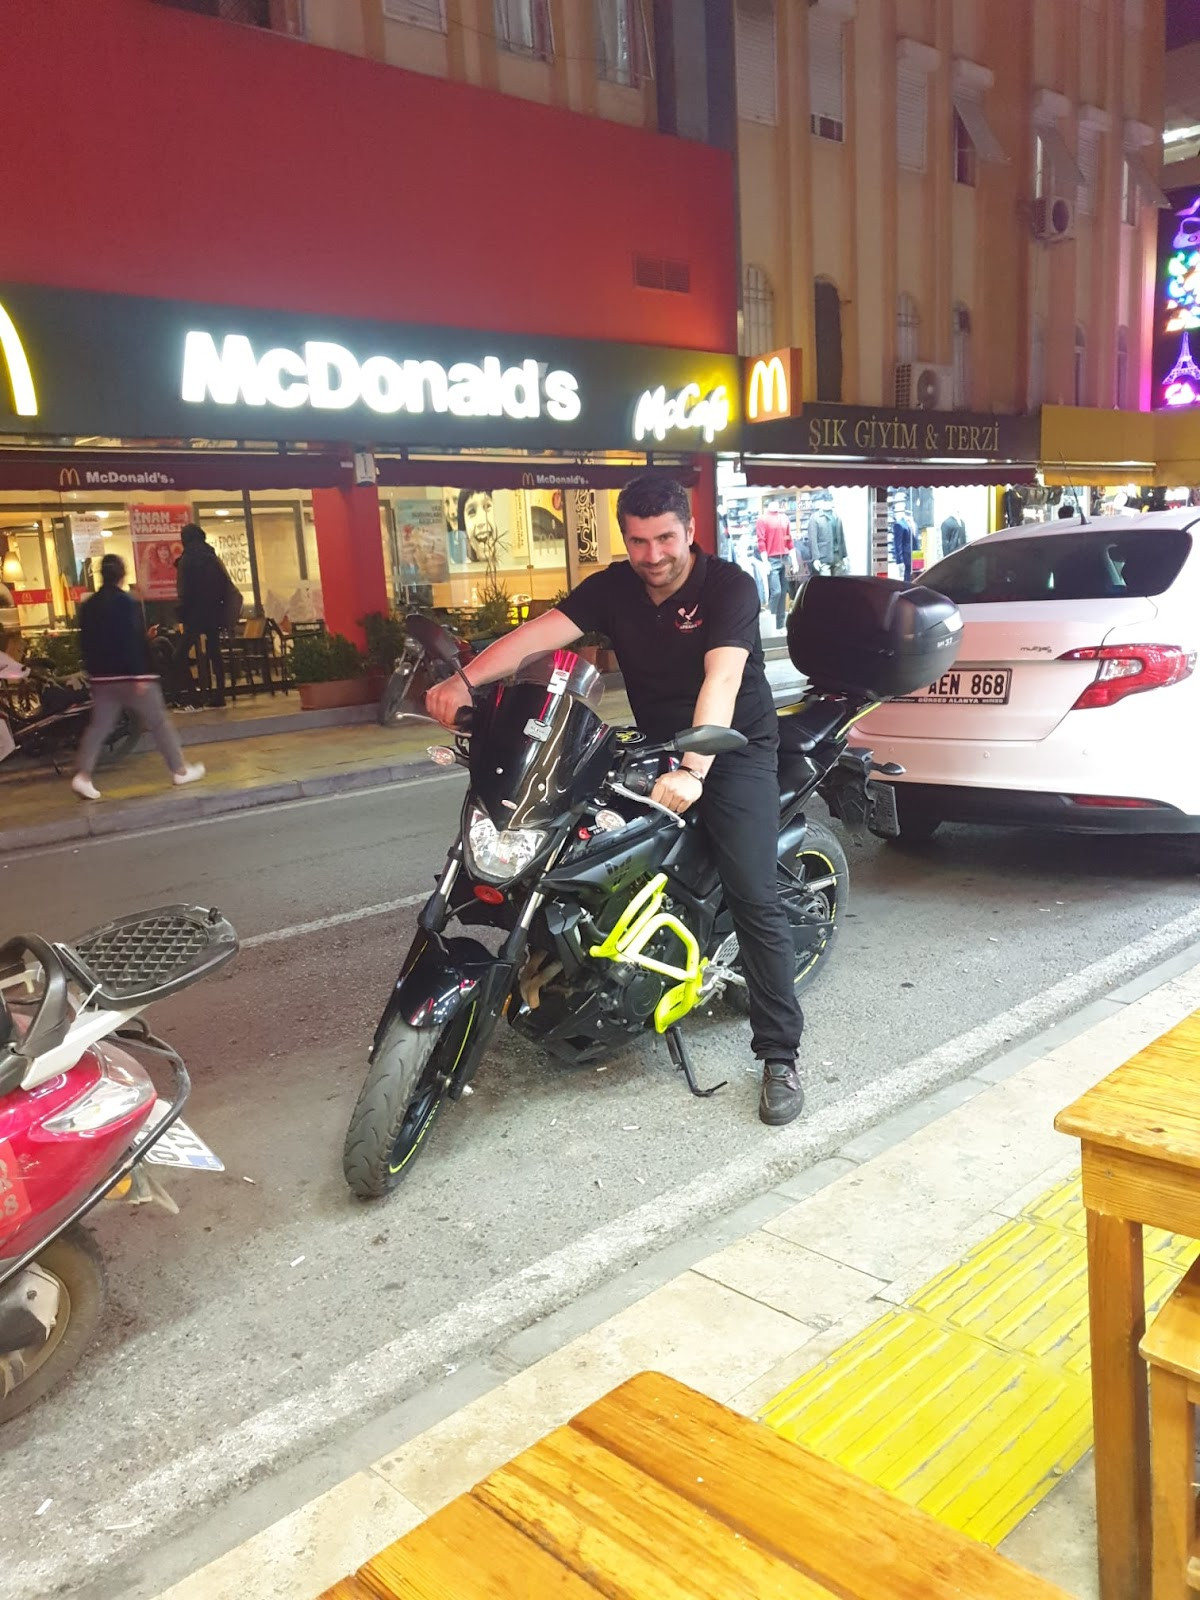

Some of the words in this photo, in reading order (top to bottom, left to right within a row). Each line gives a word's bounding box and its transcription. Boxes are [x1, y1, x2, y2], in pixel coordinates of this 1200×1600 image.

[182, 331, 581, 421] McDonald's
[808, 418, 848, 453] ŞIK
[854, 415, 918, 450] GİYİM
[925, 423, 939, 450] &
[945, 421, 1000, 451] TERZİ
[86, 471, 169, 484] McDonald's
[928, 674, 960, 695] AEN
[971, 674, 1005, 695] 868
